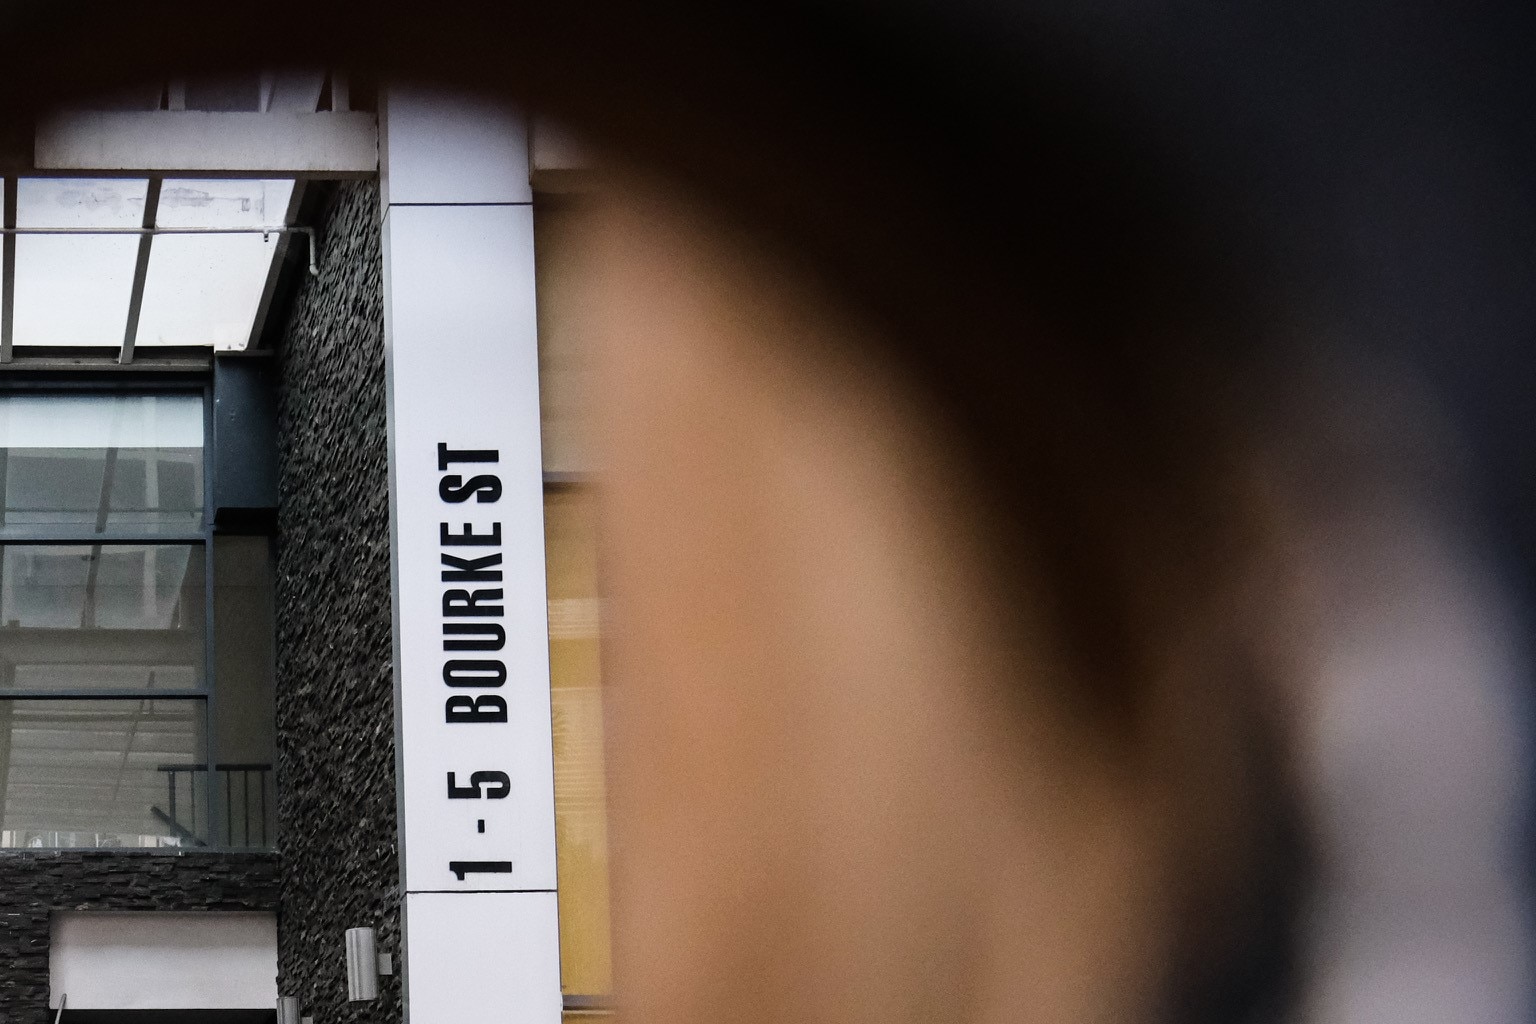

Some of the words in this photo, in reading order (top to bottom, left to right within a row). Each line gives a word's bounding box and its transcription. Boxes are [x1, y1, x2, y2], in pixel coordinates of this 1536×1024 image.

[437, 442, 503, 503] ST
[440, 522, 509, 723] BOURKE
[447, 770, 512, 799] 5
[449, 860, 513, 881] 1
